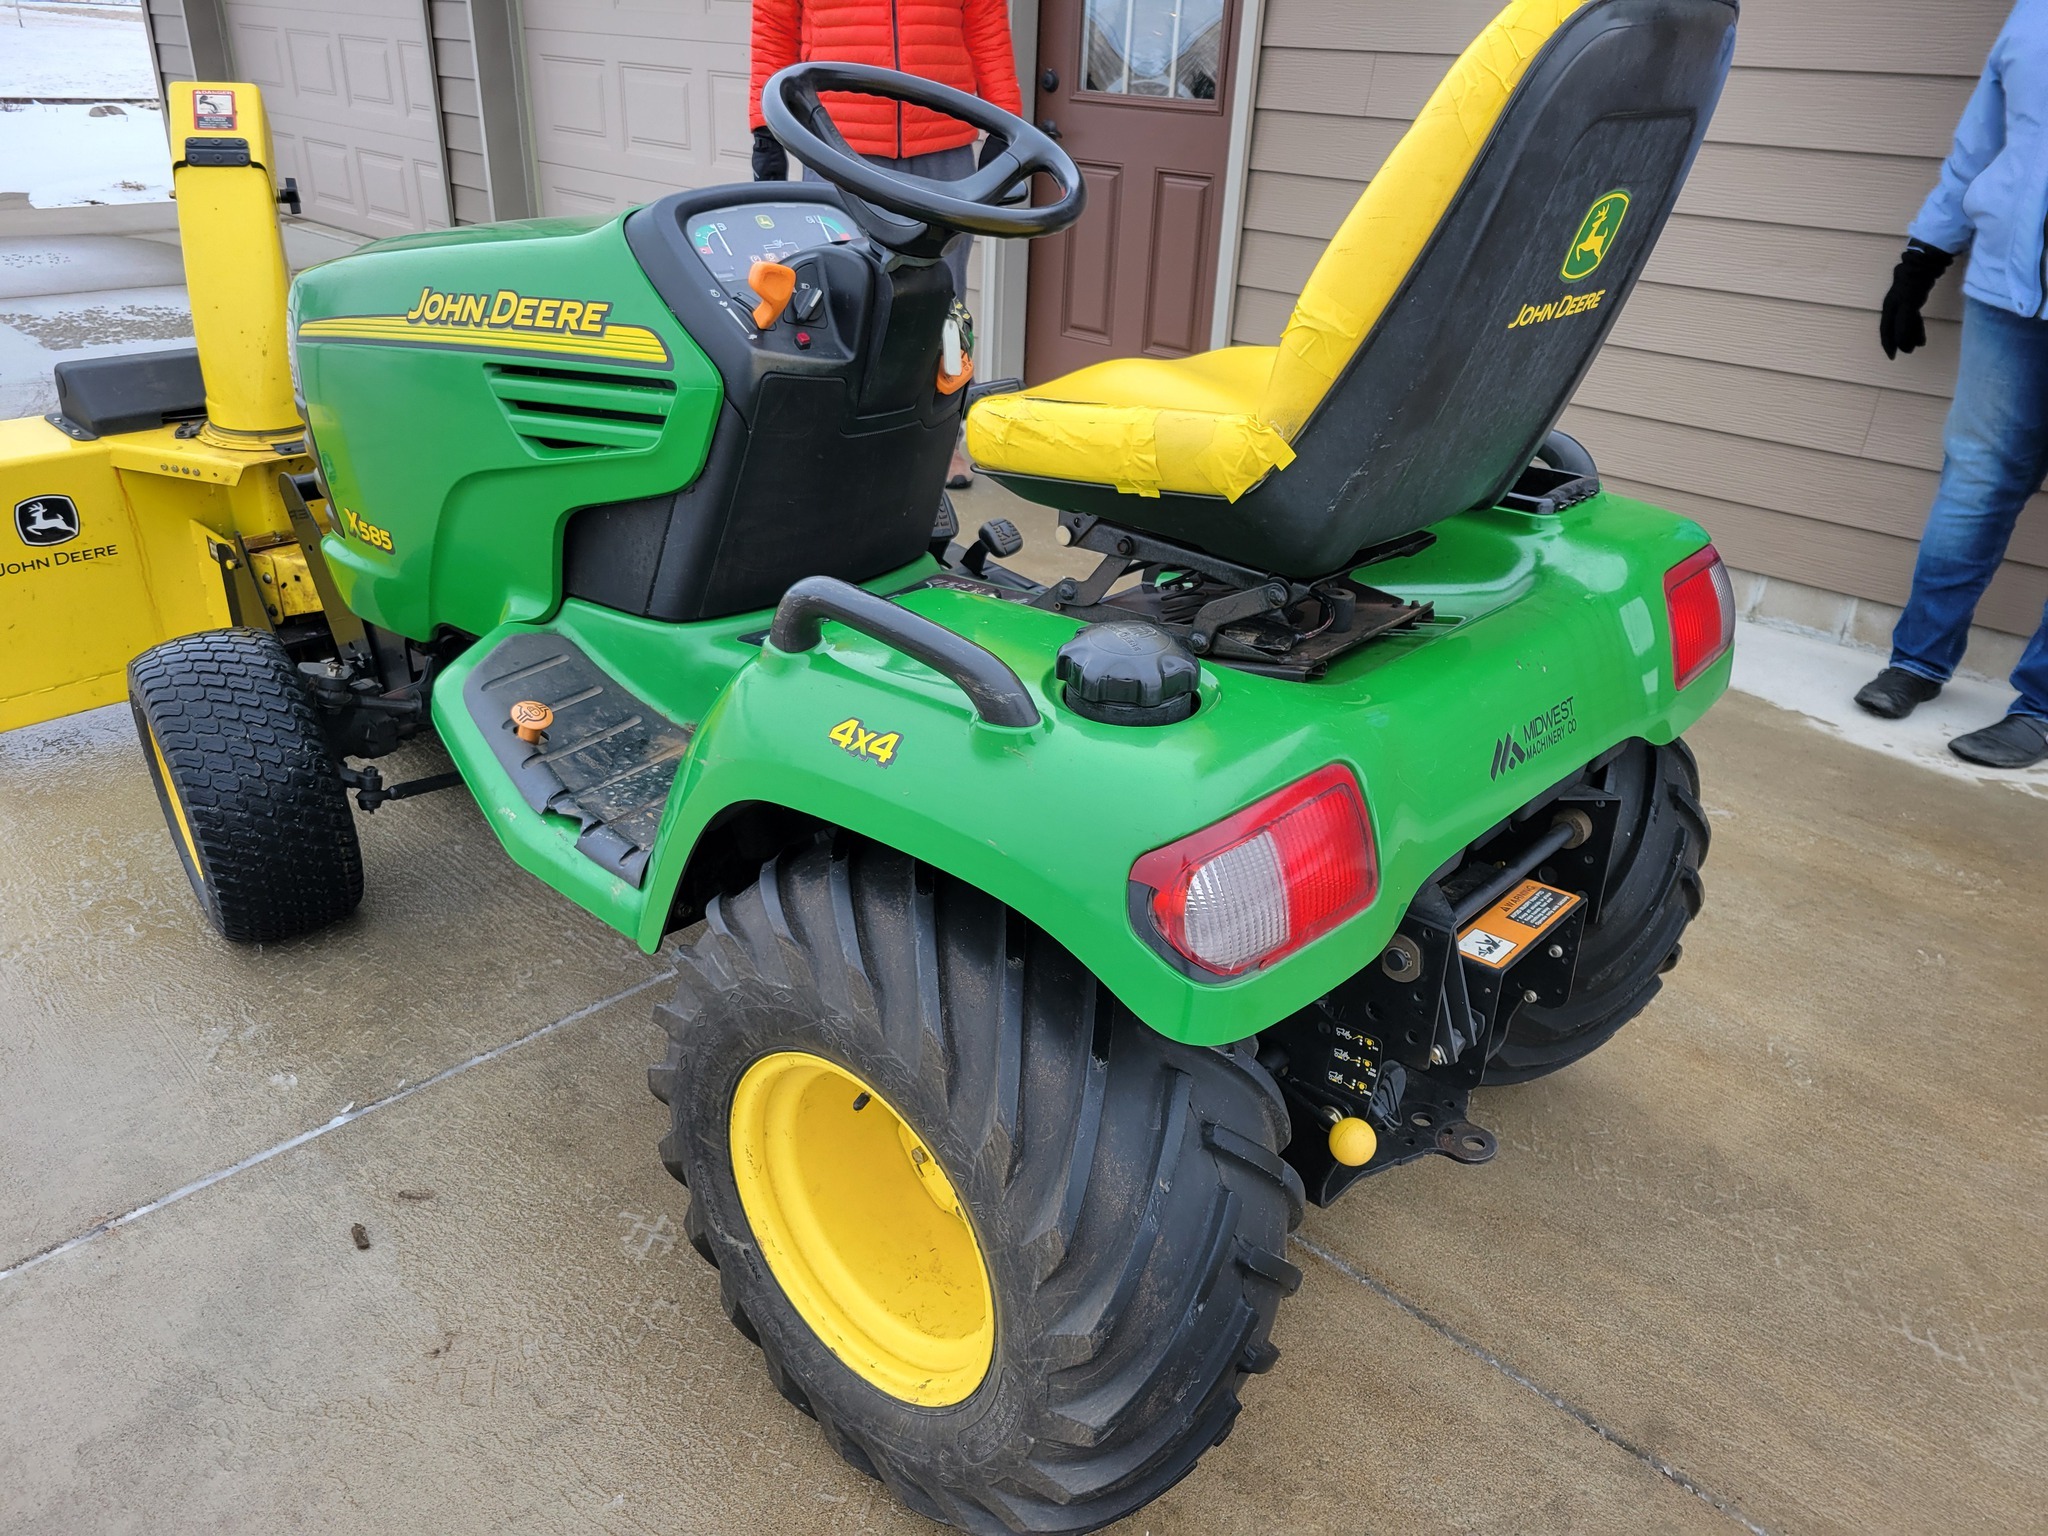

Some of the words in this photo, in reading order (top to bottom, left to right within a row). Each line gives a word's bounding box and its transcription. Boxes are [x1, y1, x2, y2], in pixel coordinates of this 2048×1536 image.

[406, 287, 491, 326] JOHN
[488, 290, 612, 336] DEERE
[1507, 302, 1559, 329] JOHN
[1554, 289, 1606, 319] DEERE
[344, 507, 393, 551] X585
[0, 557, 51, 577] JOHN
[53, 544, 119, 566] DEERE
[1523, 695, 1574, 744] MIDWEST
[1526, 725, 1566, 761] MACHINERY
[1567, 718, 1577, 734] CO
